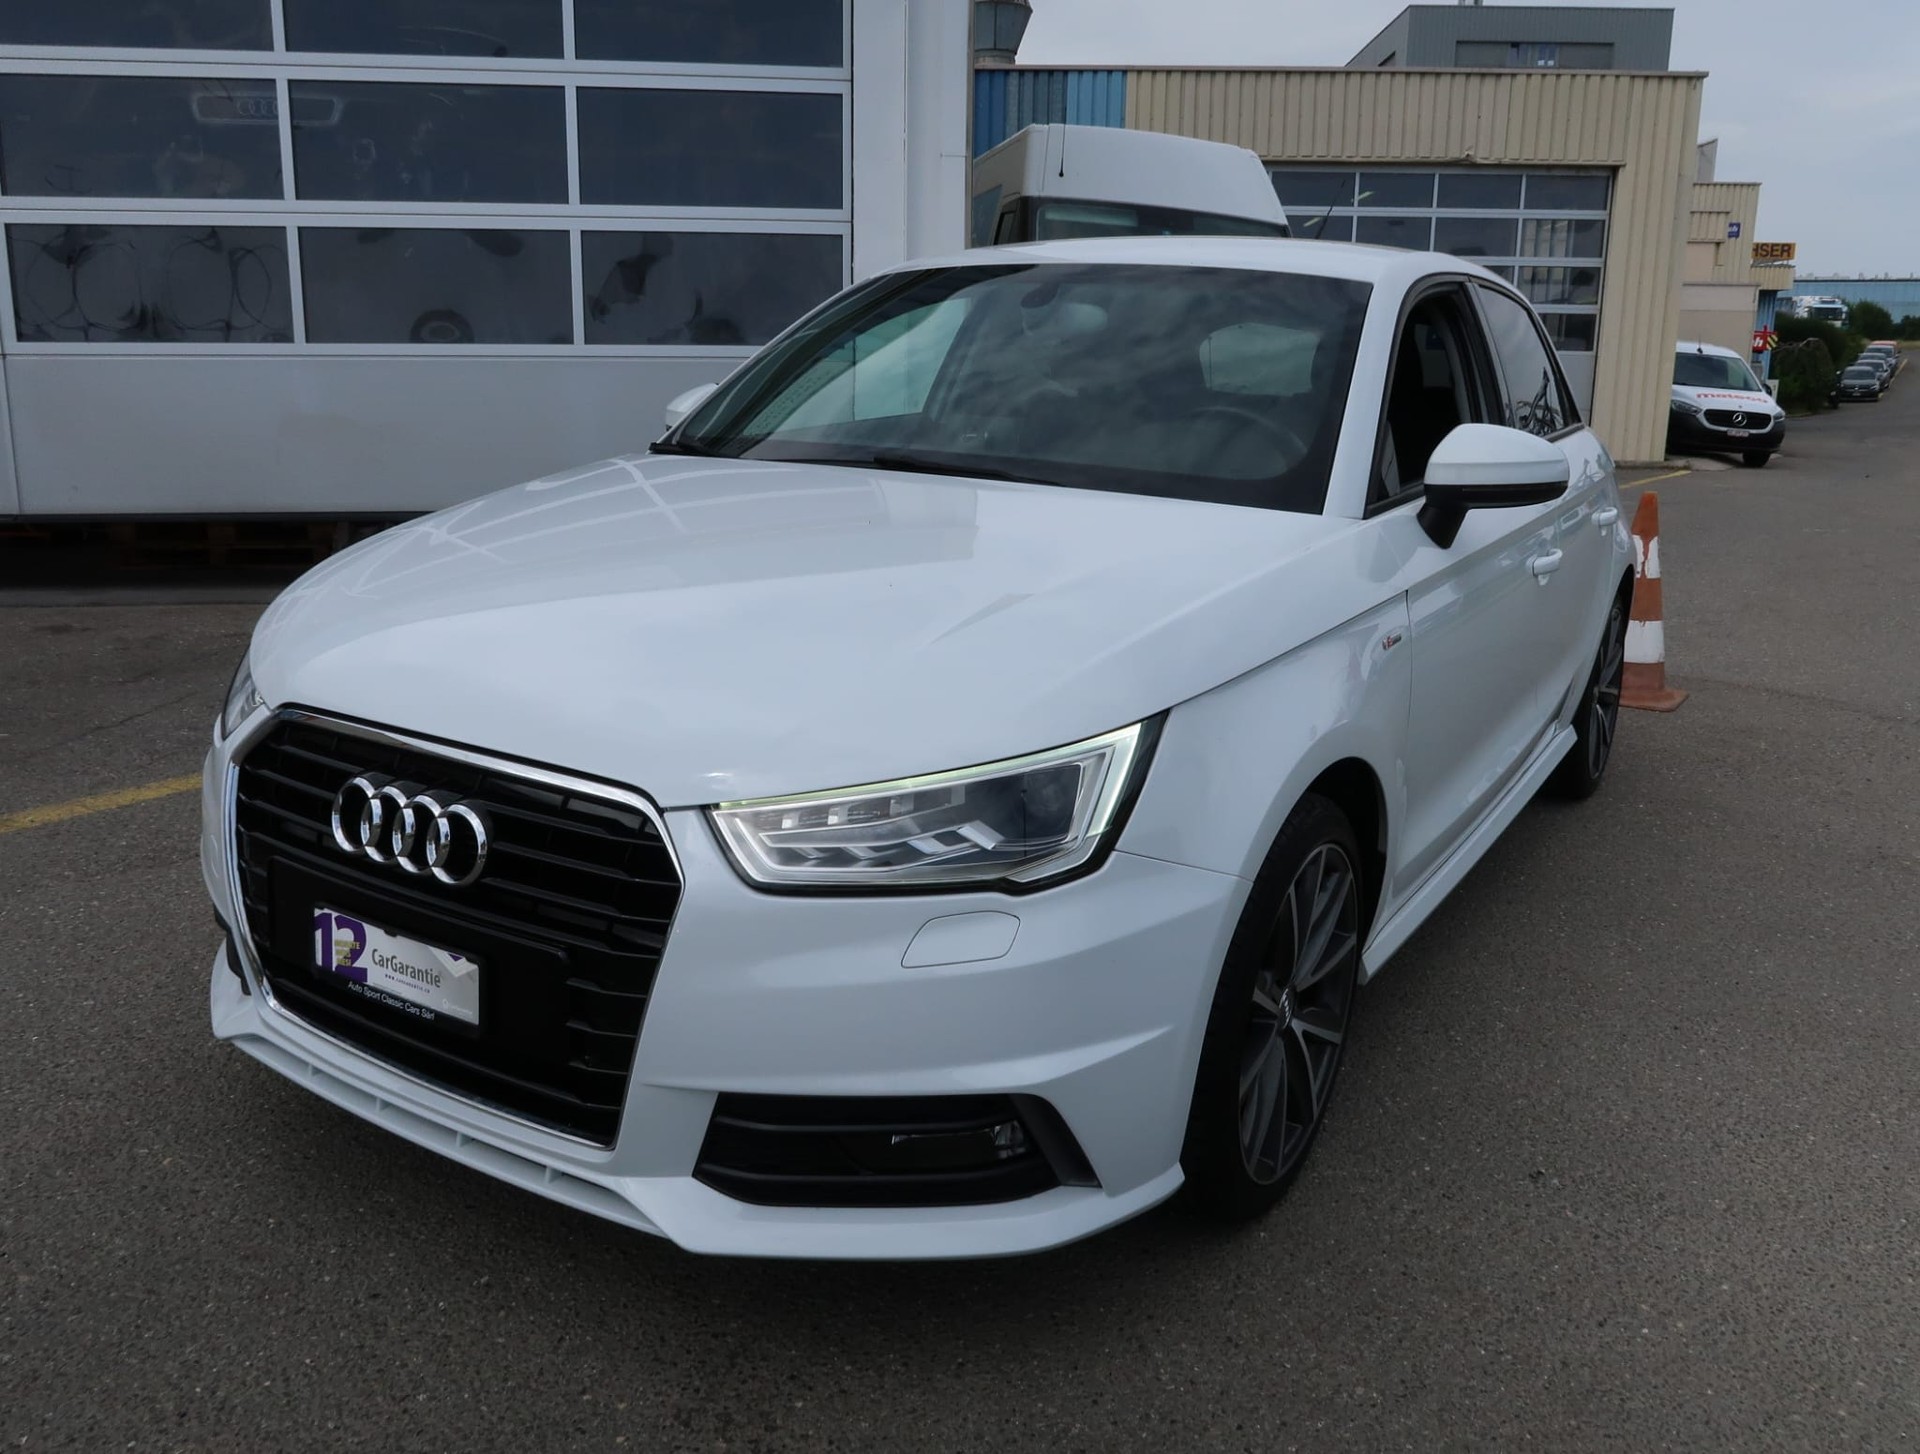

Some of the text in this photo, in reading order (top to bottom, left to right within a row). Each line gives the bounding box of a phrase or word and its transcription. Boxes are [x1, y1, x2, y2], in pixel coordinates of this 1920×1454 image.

[314, 912, 368, 983] 12
[371, 948, 441, 988] CarGarantie
[347, 980, 363, 994] Auto
[363, 986, 381, 1001] Sport
[381, 993, 405, 1009] Classic
[404, 1002, 421, 1016] Cars
